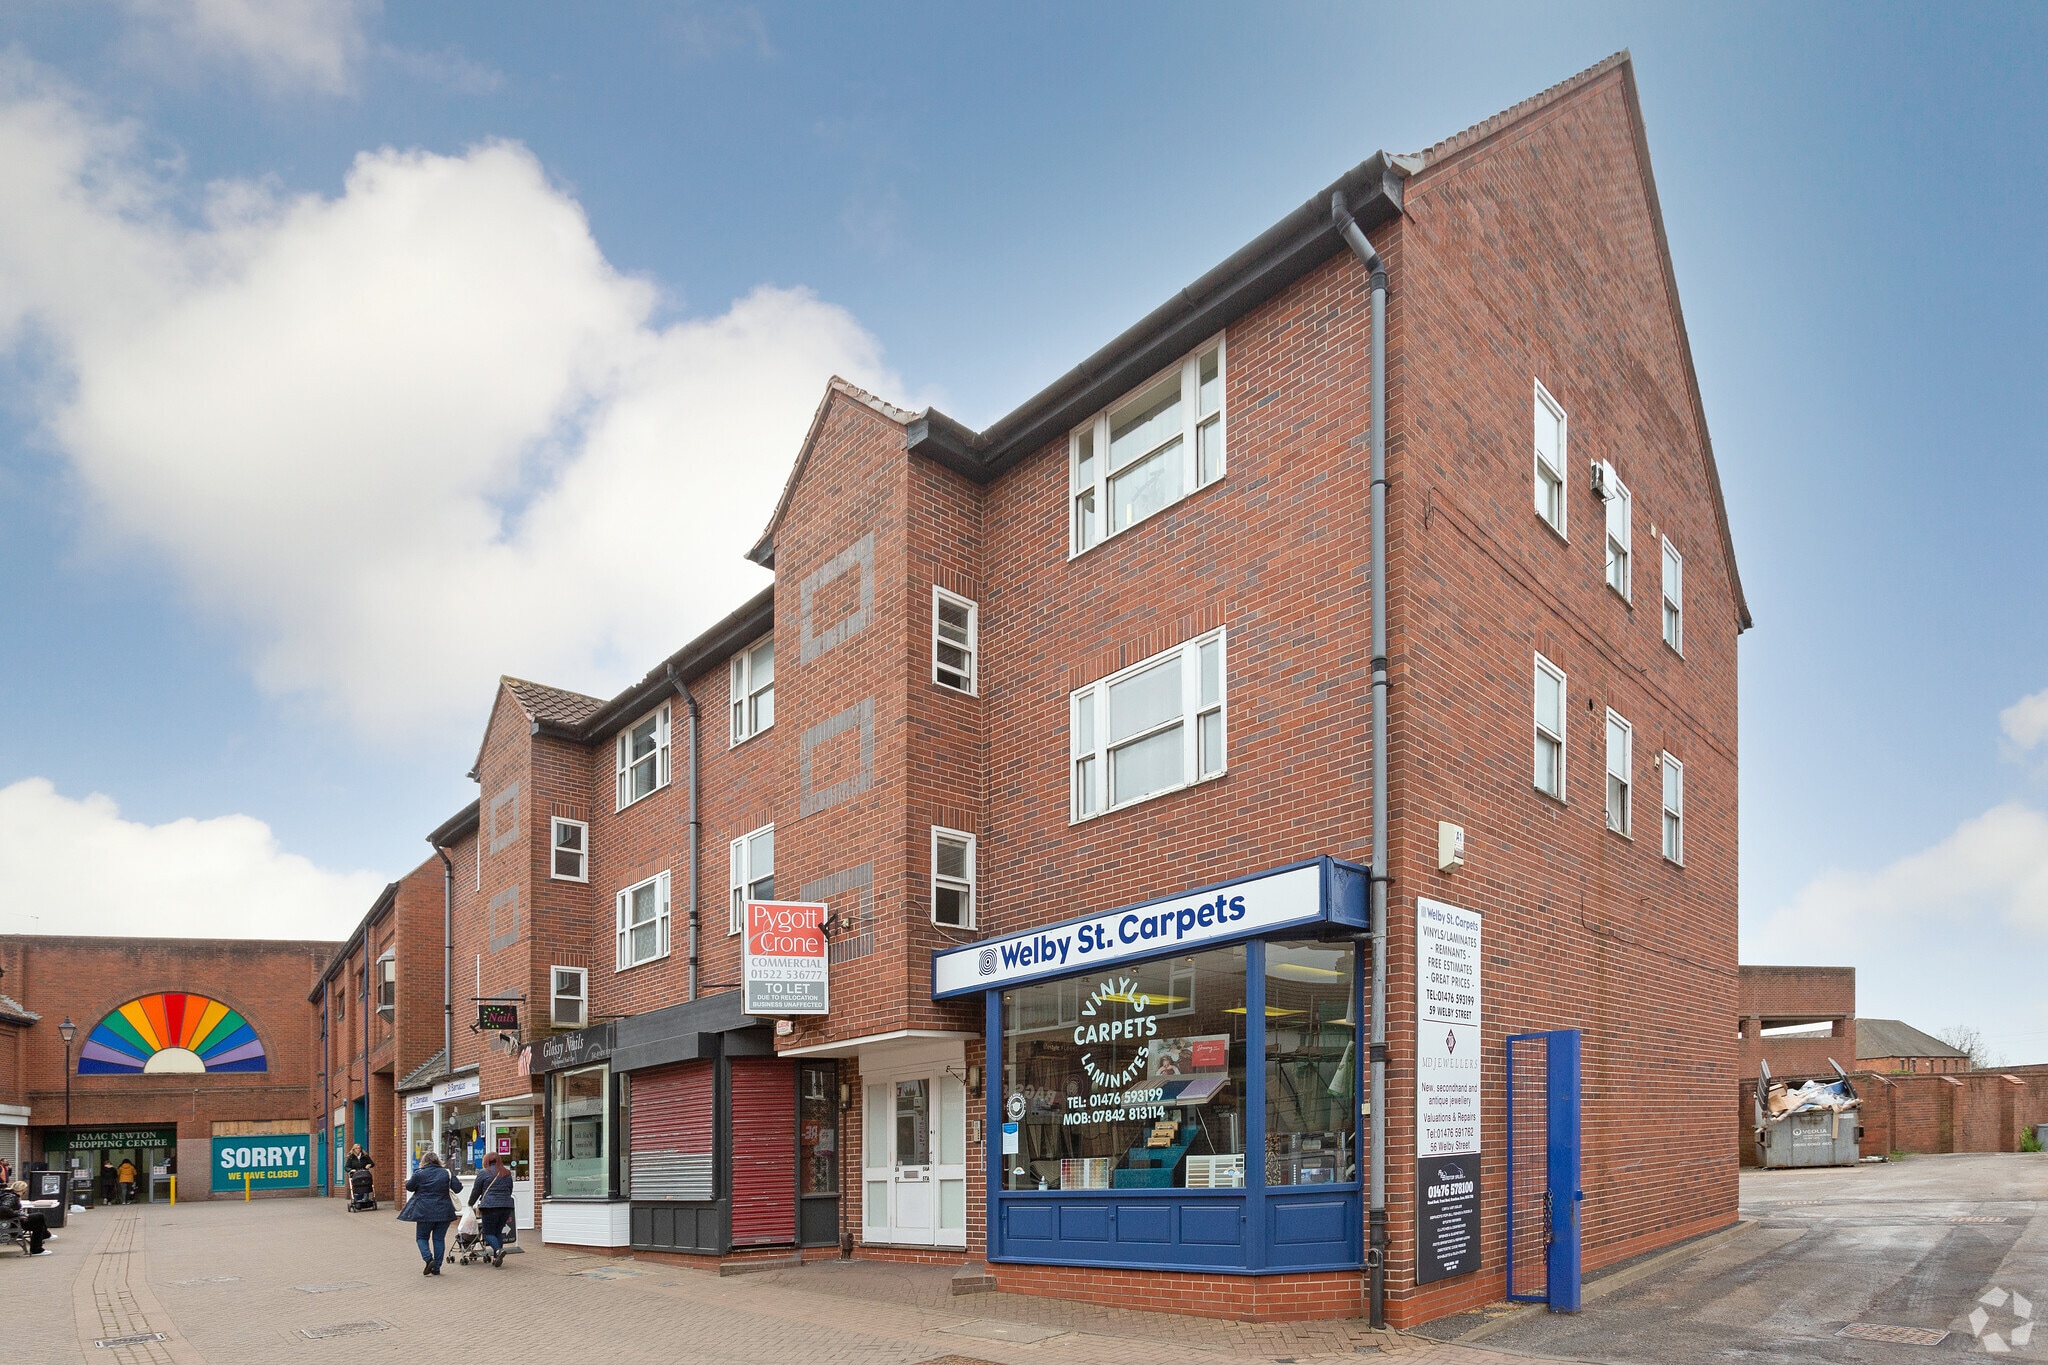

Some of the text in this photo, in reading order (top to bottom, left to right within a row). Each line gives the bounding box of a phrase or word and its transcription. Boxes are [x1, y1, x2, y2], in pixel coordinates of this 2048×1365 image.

[754, 906, 817, 933] Pygott
[1427, 907, 1479, 932] Welby St. Carpets
[1001, 894, 1246, 970] Welby St. Carpets
[1423, 925, 1477, 948] VINYLS/LAMINATES
[760, 932, 818, 953] Crone
[1435, 943, 1466, 960] REMNANTS
[752, 957, 822, 969] COMMERCIAL
[1428, 957, 1473, 976] FREE ESTIMATES
[751, 969, 822, 980] 01522 536777
[1430, 972, 1470, 989] GREAT PRICES
[765, 983, 810, 994] TO LET
[1081, 976, 1150, 1016] VINYLS
[1426, 989, 1475, 1006] TEL:01476 593199
[488, 1012, 515, 1023] Nails
[1429, 1005, 1472, 1020] 59 WELBY STREET
[1074, 1015, 1157, 1045] CARPETS
[543, 1033, 584, 1060] Glossy Nails
[1081, 1046, 1149, 1088] LAMINATES
[1421, 1082, 1478, 1093] New, secondhand and
[1067, 1088, 1163, 1109] TEL: 01476 593199
[1428, 1096, 1471, 1107] antique jewellery
[1063, 1105, 1165, 1125] MOB: 07842 813114
[1423, 1112, 1476, 1123] Valuations & Repairs
[76, 1131, 157, 1141] ISAAC NEWTON
[1426, 1127, 1474, 1139] Tel:01476 591762
[69, 1138, 168, 1149] SHOPPING CENTRE
[1430, 1140, 1471, 1153] 56 Welby Street
[221, 1146, 306, 1168] SORRY!
[228, 1172, 241, 1180] WE
[267, 1170, 299, 1179] CLOSED
[1428, 1181, 1474, 1198] 01476 578100
